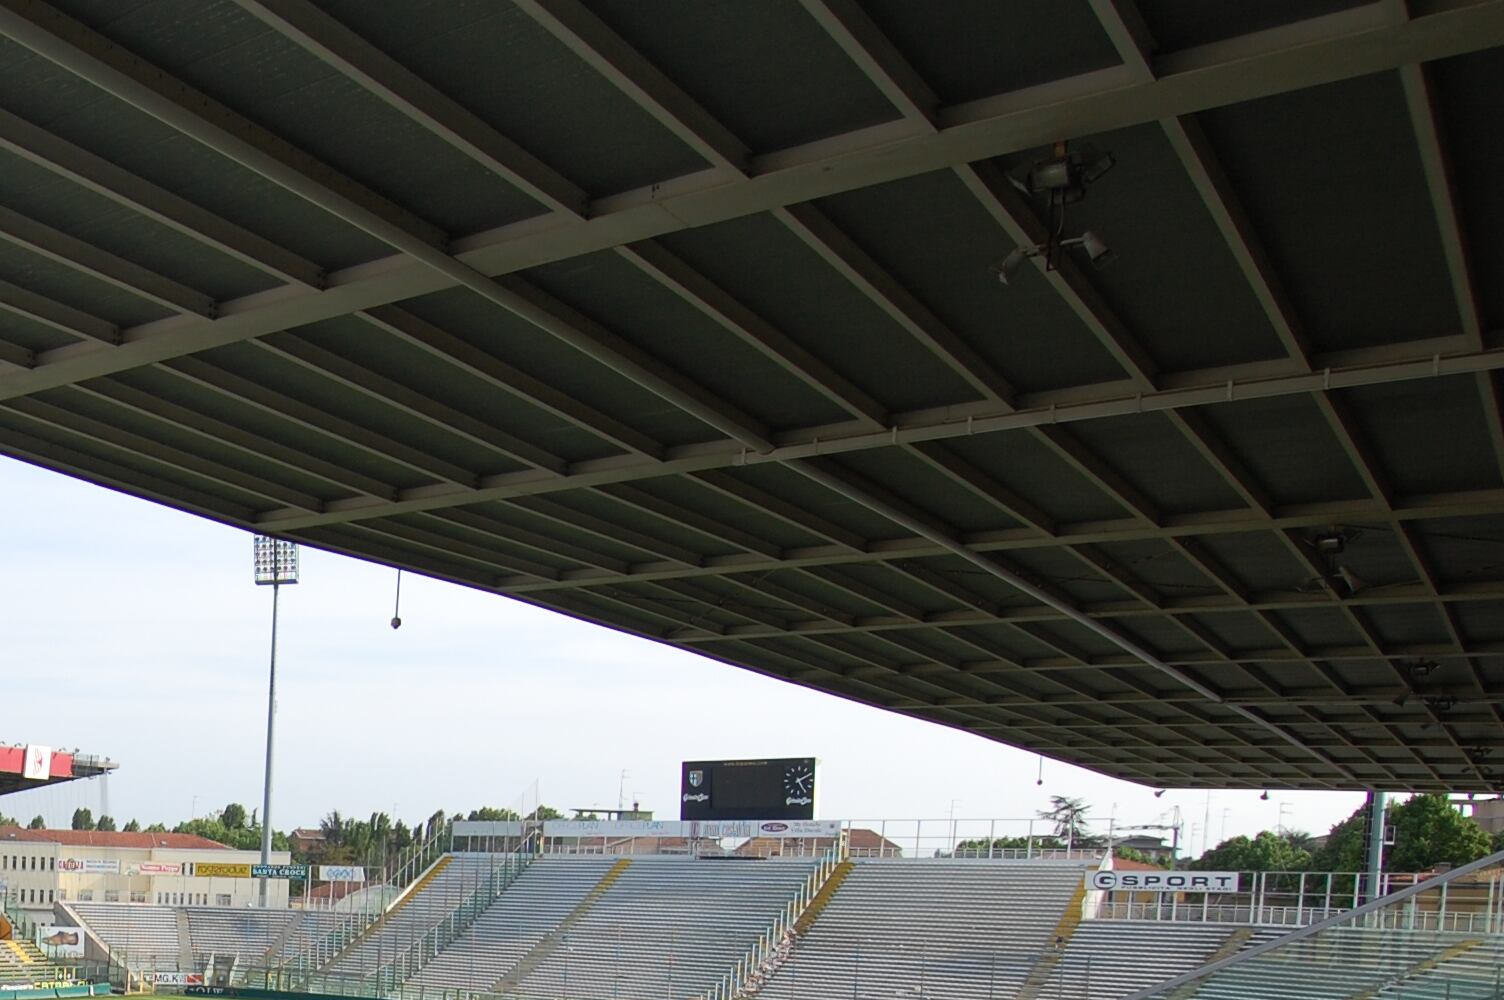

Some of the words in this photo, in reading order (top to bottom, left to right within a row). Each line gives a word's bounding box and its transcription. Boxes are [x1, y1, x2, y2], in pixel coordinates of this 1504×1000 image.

[253, 868, 278, 876] SANTA
[279, 868, 306, 876] CROCE
[1121, 875, 1232, 887] SPORT
